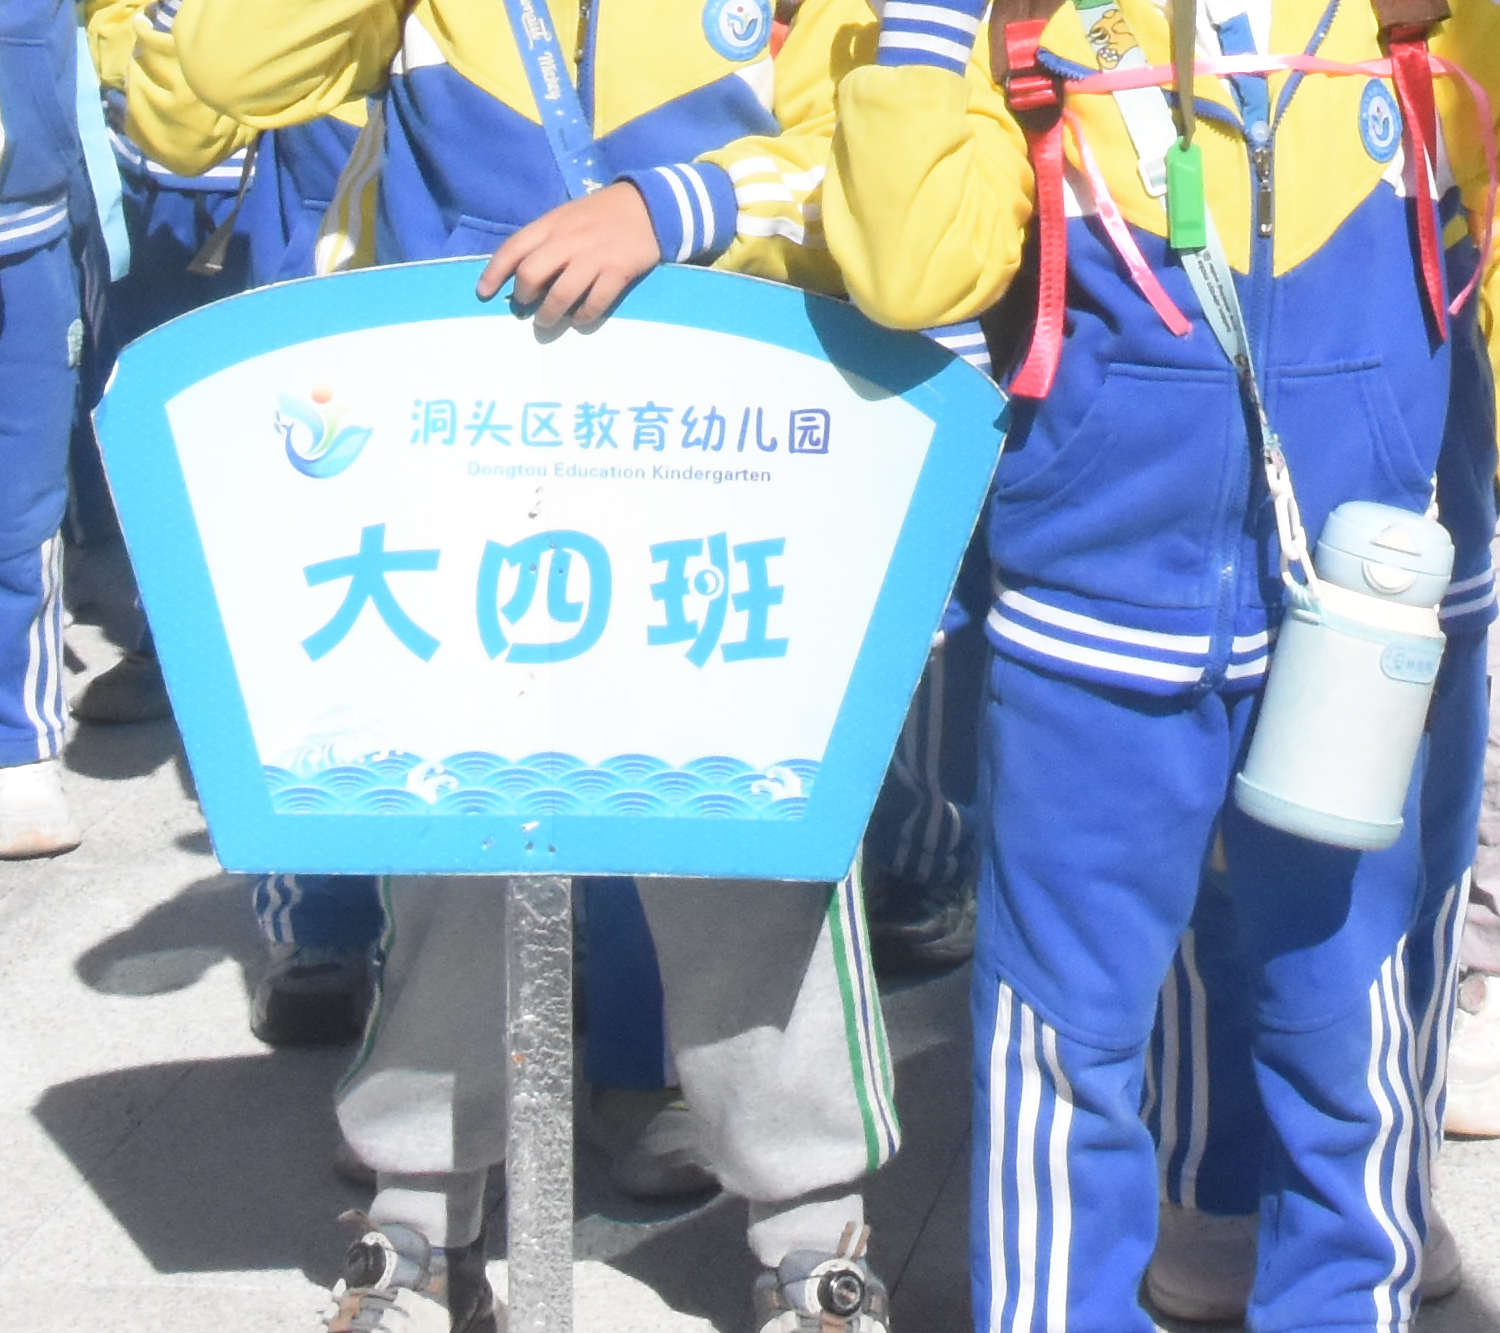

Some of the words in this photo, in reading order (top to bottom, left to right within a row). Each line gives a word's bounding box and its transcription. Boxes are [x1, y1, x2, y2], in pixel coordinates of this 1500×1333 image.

[409, 398, 832, 456] 洞头区教育幼儿园
[466, 460, 548, 482] Dongtou
[554, 461, 646, 480] Education
[652, 463, 772, 485] Kindergarten
[300, 523, 789, 668] 大四班
